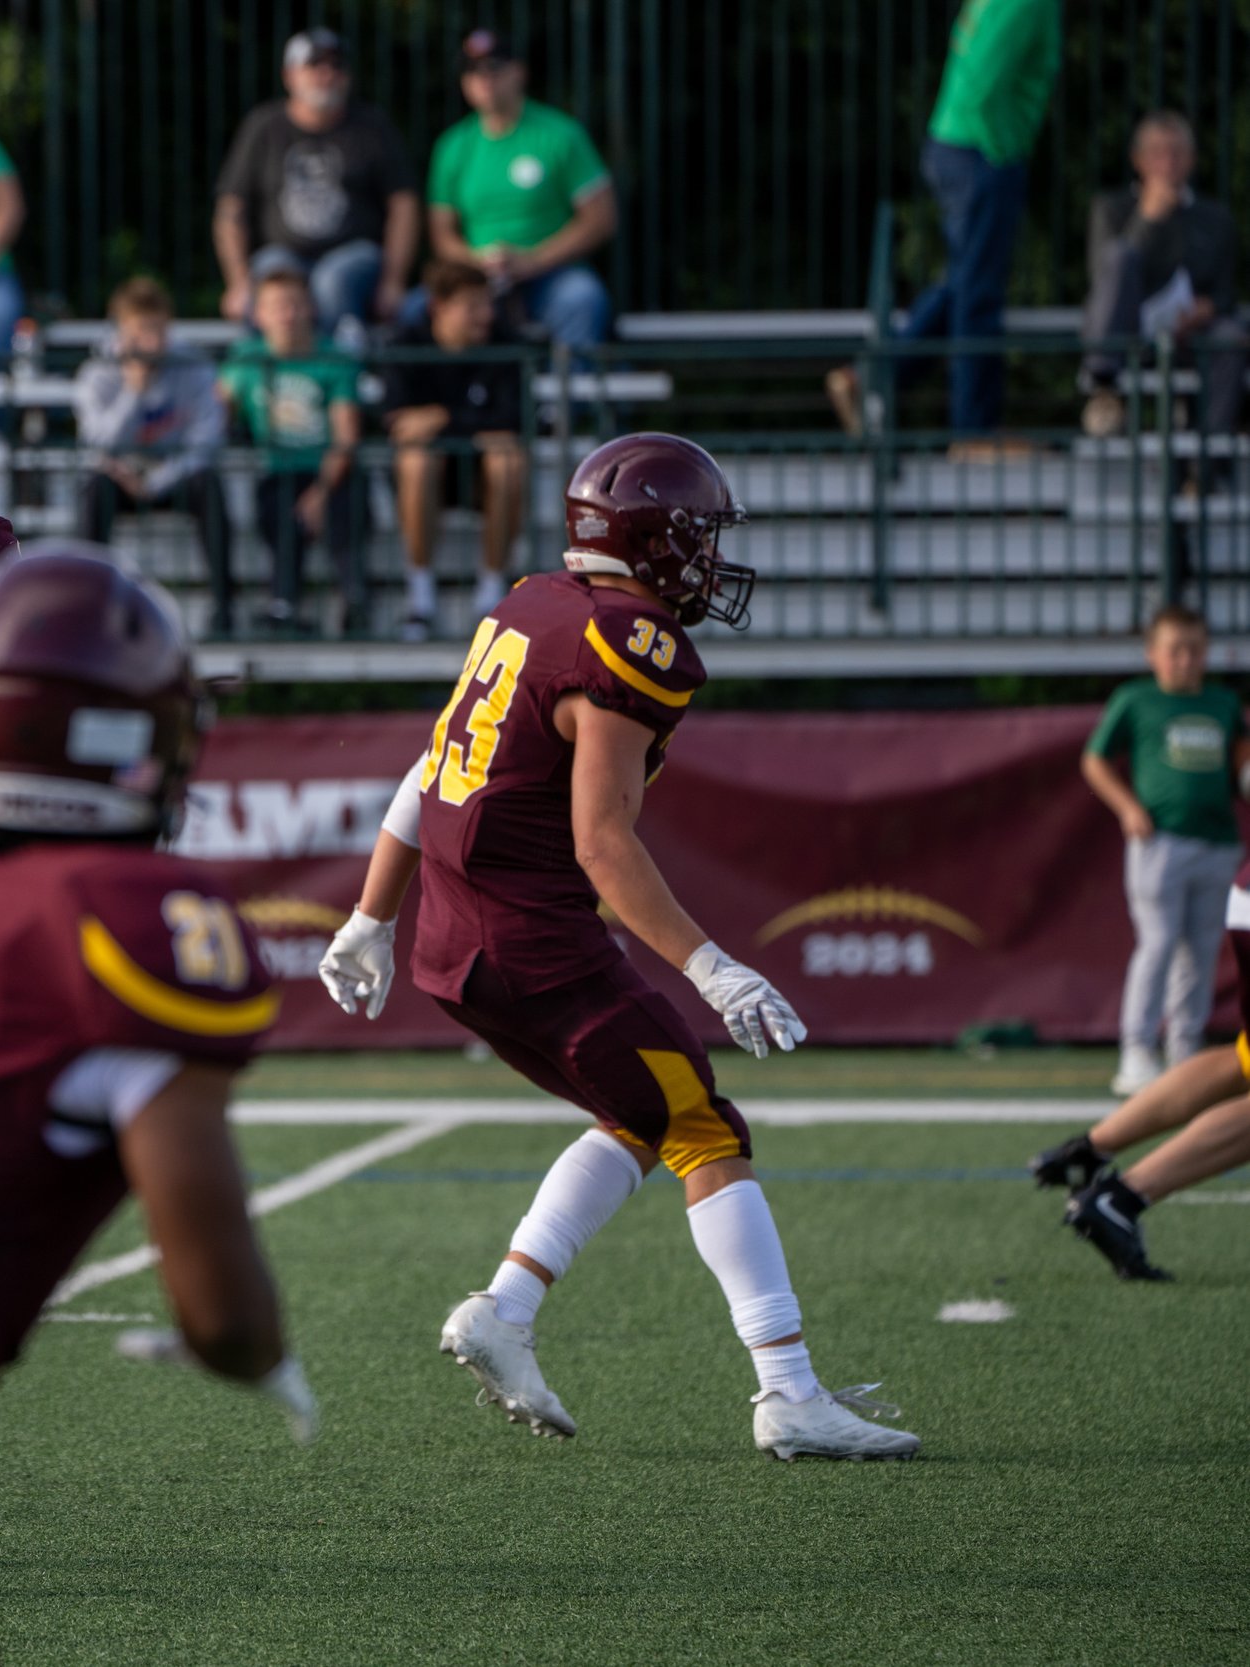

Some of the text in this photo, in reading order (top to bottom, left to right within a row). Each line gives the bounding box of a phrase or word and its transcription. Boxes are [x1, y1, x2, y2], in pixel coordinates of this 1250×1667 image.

[626, 617, 678, 671] 33
[419, 616, 531, 807] 33
[161, 889, 250, 993] 21
